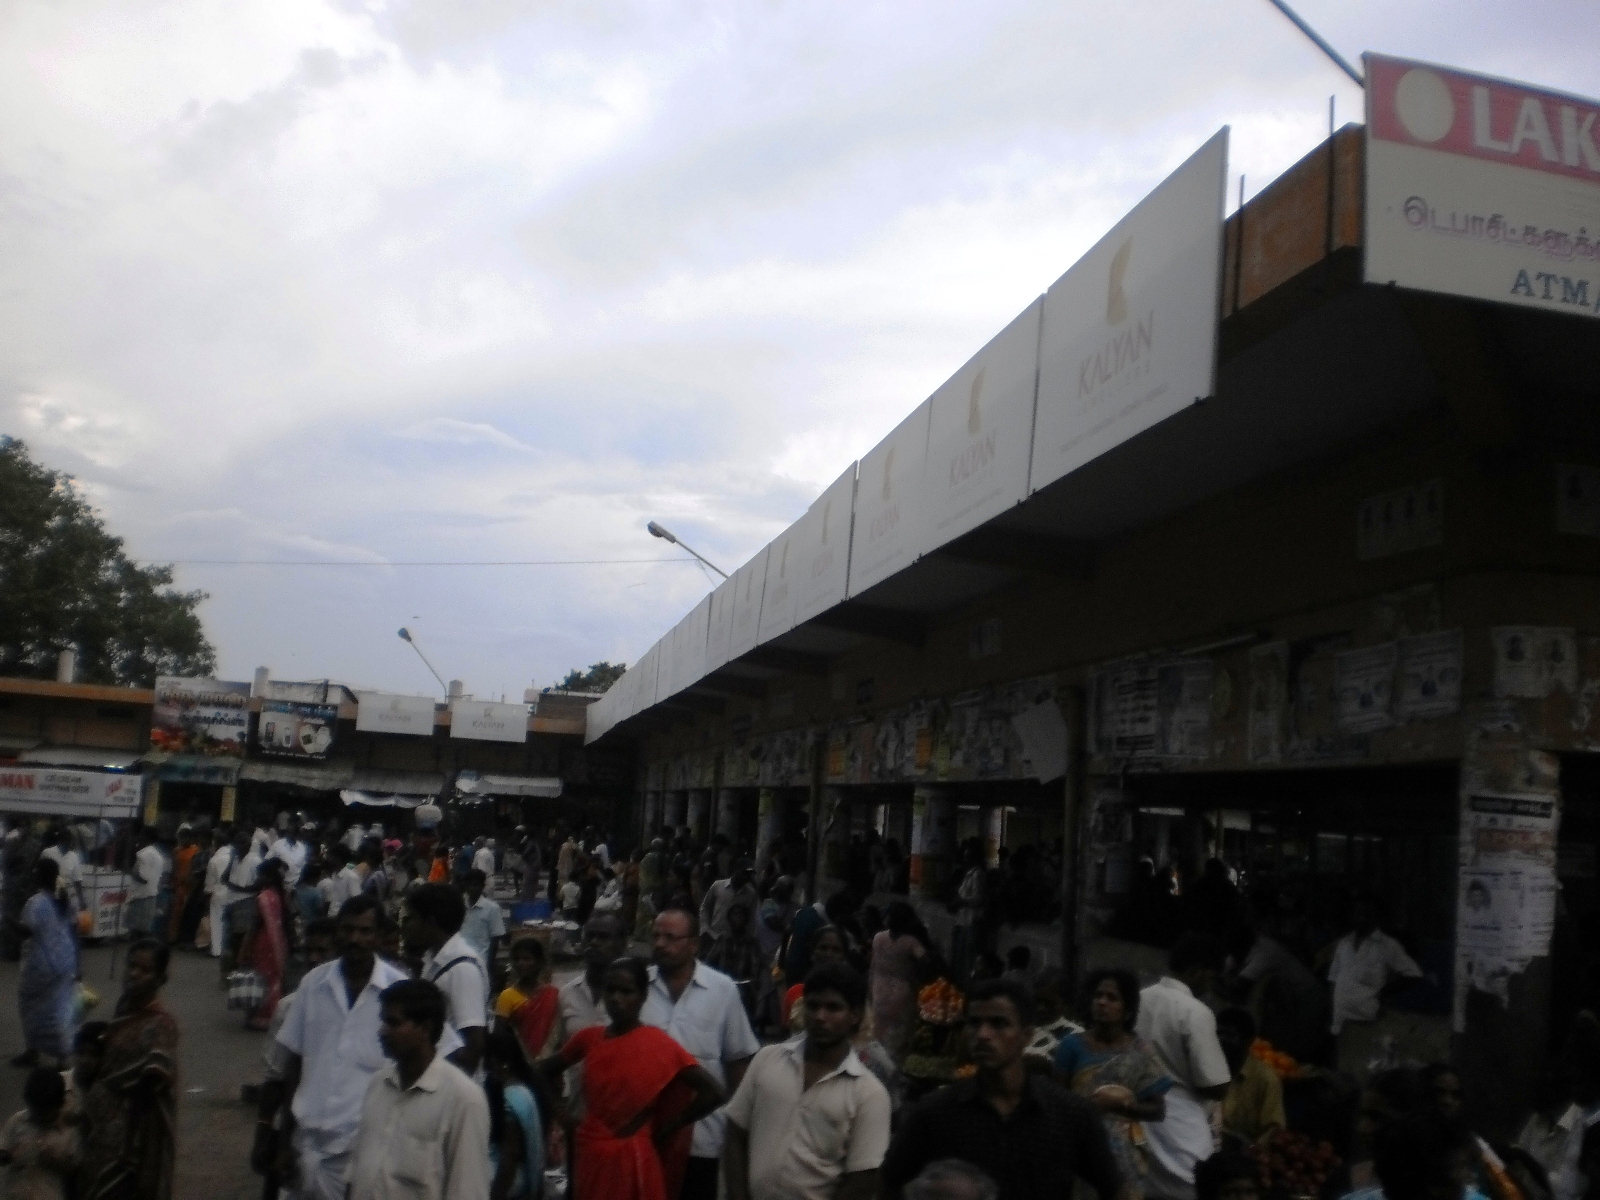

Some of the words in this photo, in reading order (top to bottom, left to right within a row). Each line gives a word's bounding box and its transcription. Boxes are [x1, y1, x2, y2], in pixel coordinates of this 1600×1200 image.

[1471, 84, 1600, 173] LAK
[1510, 269, 1600, 314] ATM
[1077, 310, 1154, 400] KALYAN
[471, 719, 506, 731] KALYAN
